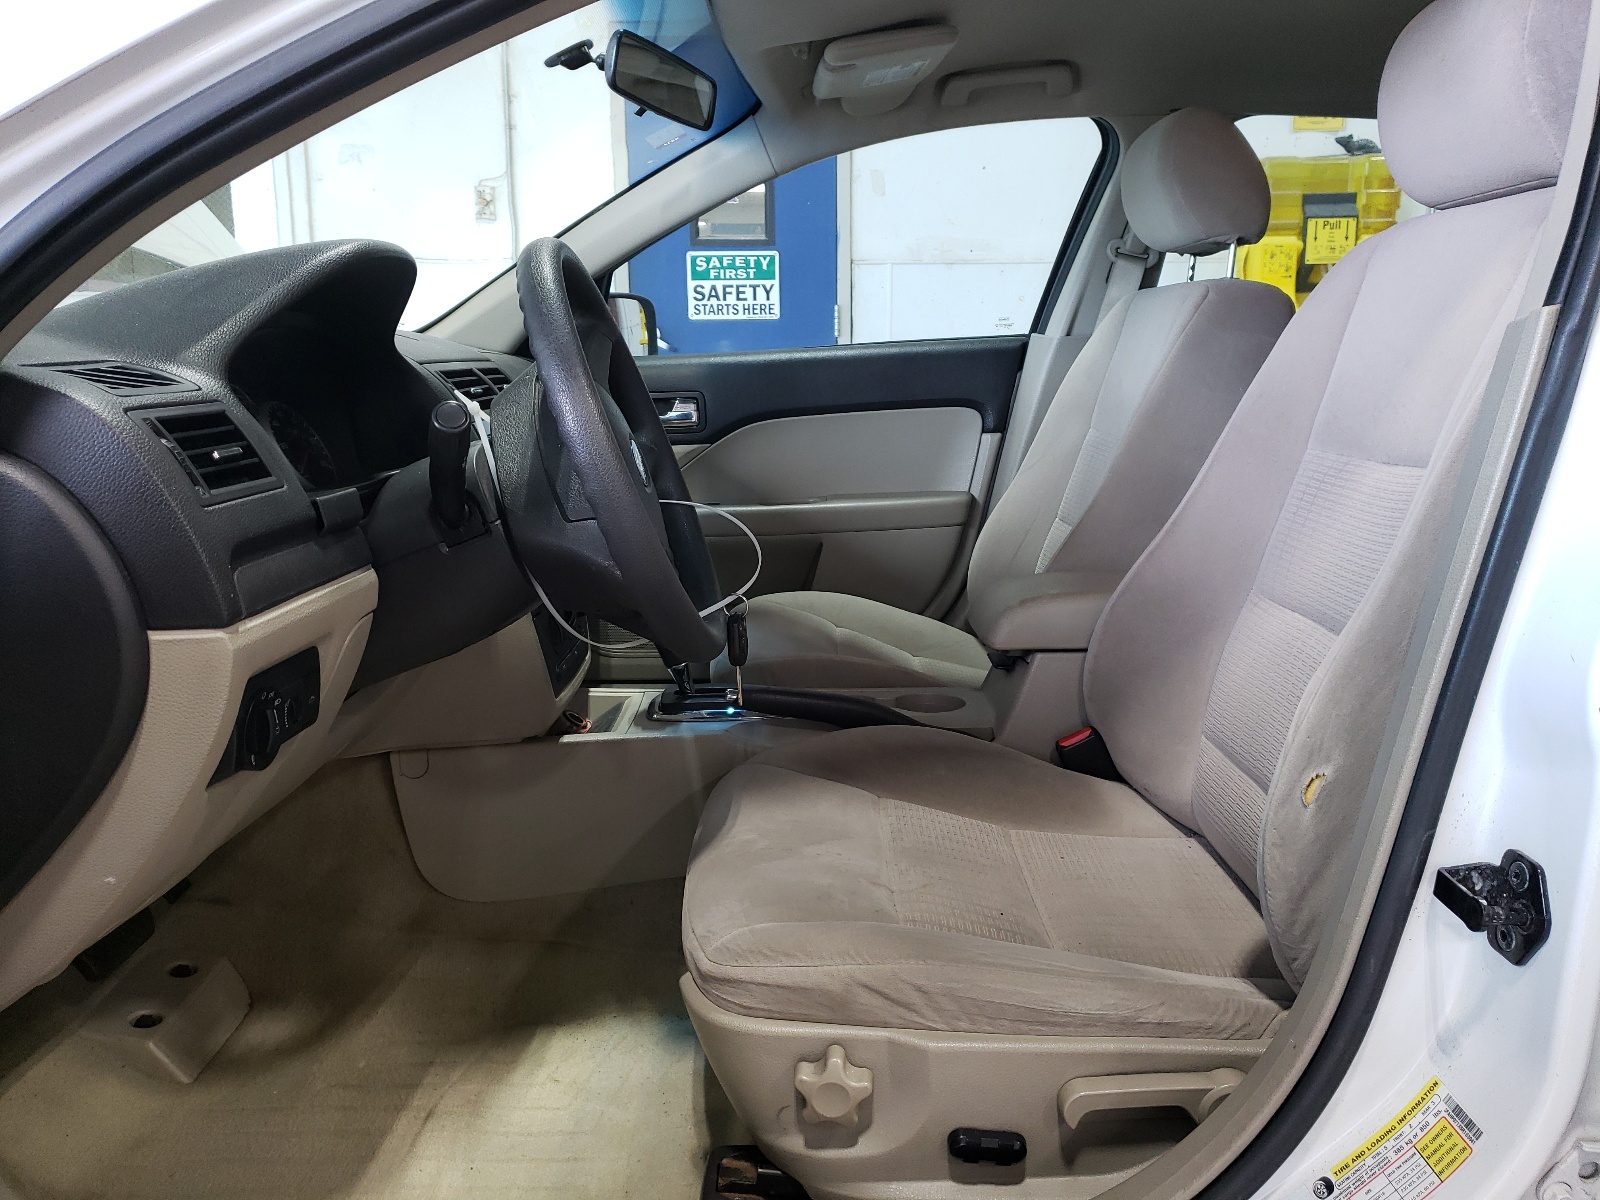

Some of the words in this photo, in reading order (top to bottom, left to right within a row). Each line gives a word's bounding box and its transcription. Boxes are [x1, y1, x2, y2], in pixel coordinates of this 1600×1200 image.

[1322, 220, 1342, 230] Pull
[695, 256, 771, 271] SAFETY
[710, 269, 756, 279] FIRST
[693, 284, 775, 301] SAFETY
[693, 303, 739, 316] STARTS
[742, 303, 776, 315] HERE
[1333, 1162, 1350, 1177] TIRE
[1351, 1150, 1366, 1164] AND
[1366, 1125, 1397, 1151] LOADING
[1397, 1080, 1439, 1126] INFORMATION
[1405, 1138, 1414, 1147] kg
[1420, 1121, 1430, 1132] 850
[1420, 1143, 1429, 1153] SEE
[1426, 1142, 1445, 1161] MANUAL
[1445, 1131, 1454, 1143] FOR
[1433, 1142, 1459, 1168] ADDITIONAL
[1438, 1145, 1468, 1177] INFORMATION
